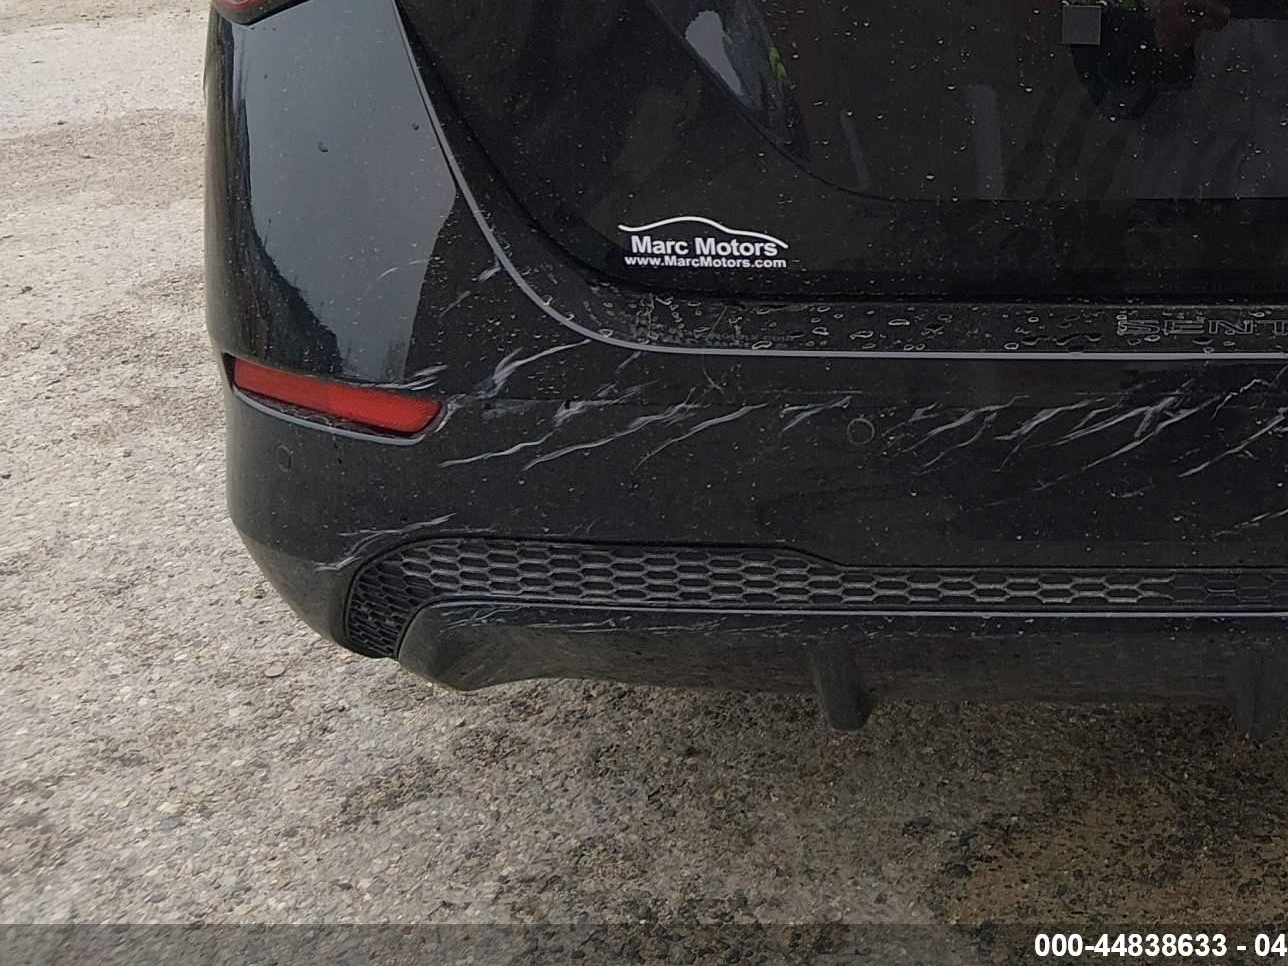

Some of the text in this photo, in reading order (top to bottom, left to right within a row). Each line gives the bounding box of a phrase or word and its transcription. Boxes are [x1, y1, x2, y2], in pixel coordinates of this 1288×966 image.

[631, 235, 778, 257] Marc Motors
[624, 255, 787, 269] www.MarcMotors.com
